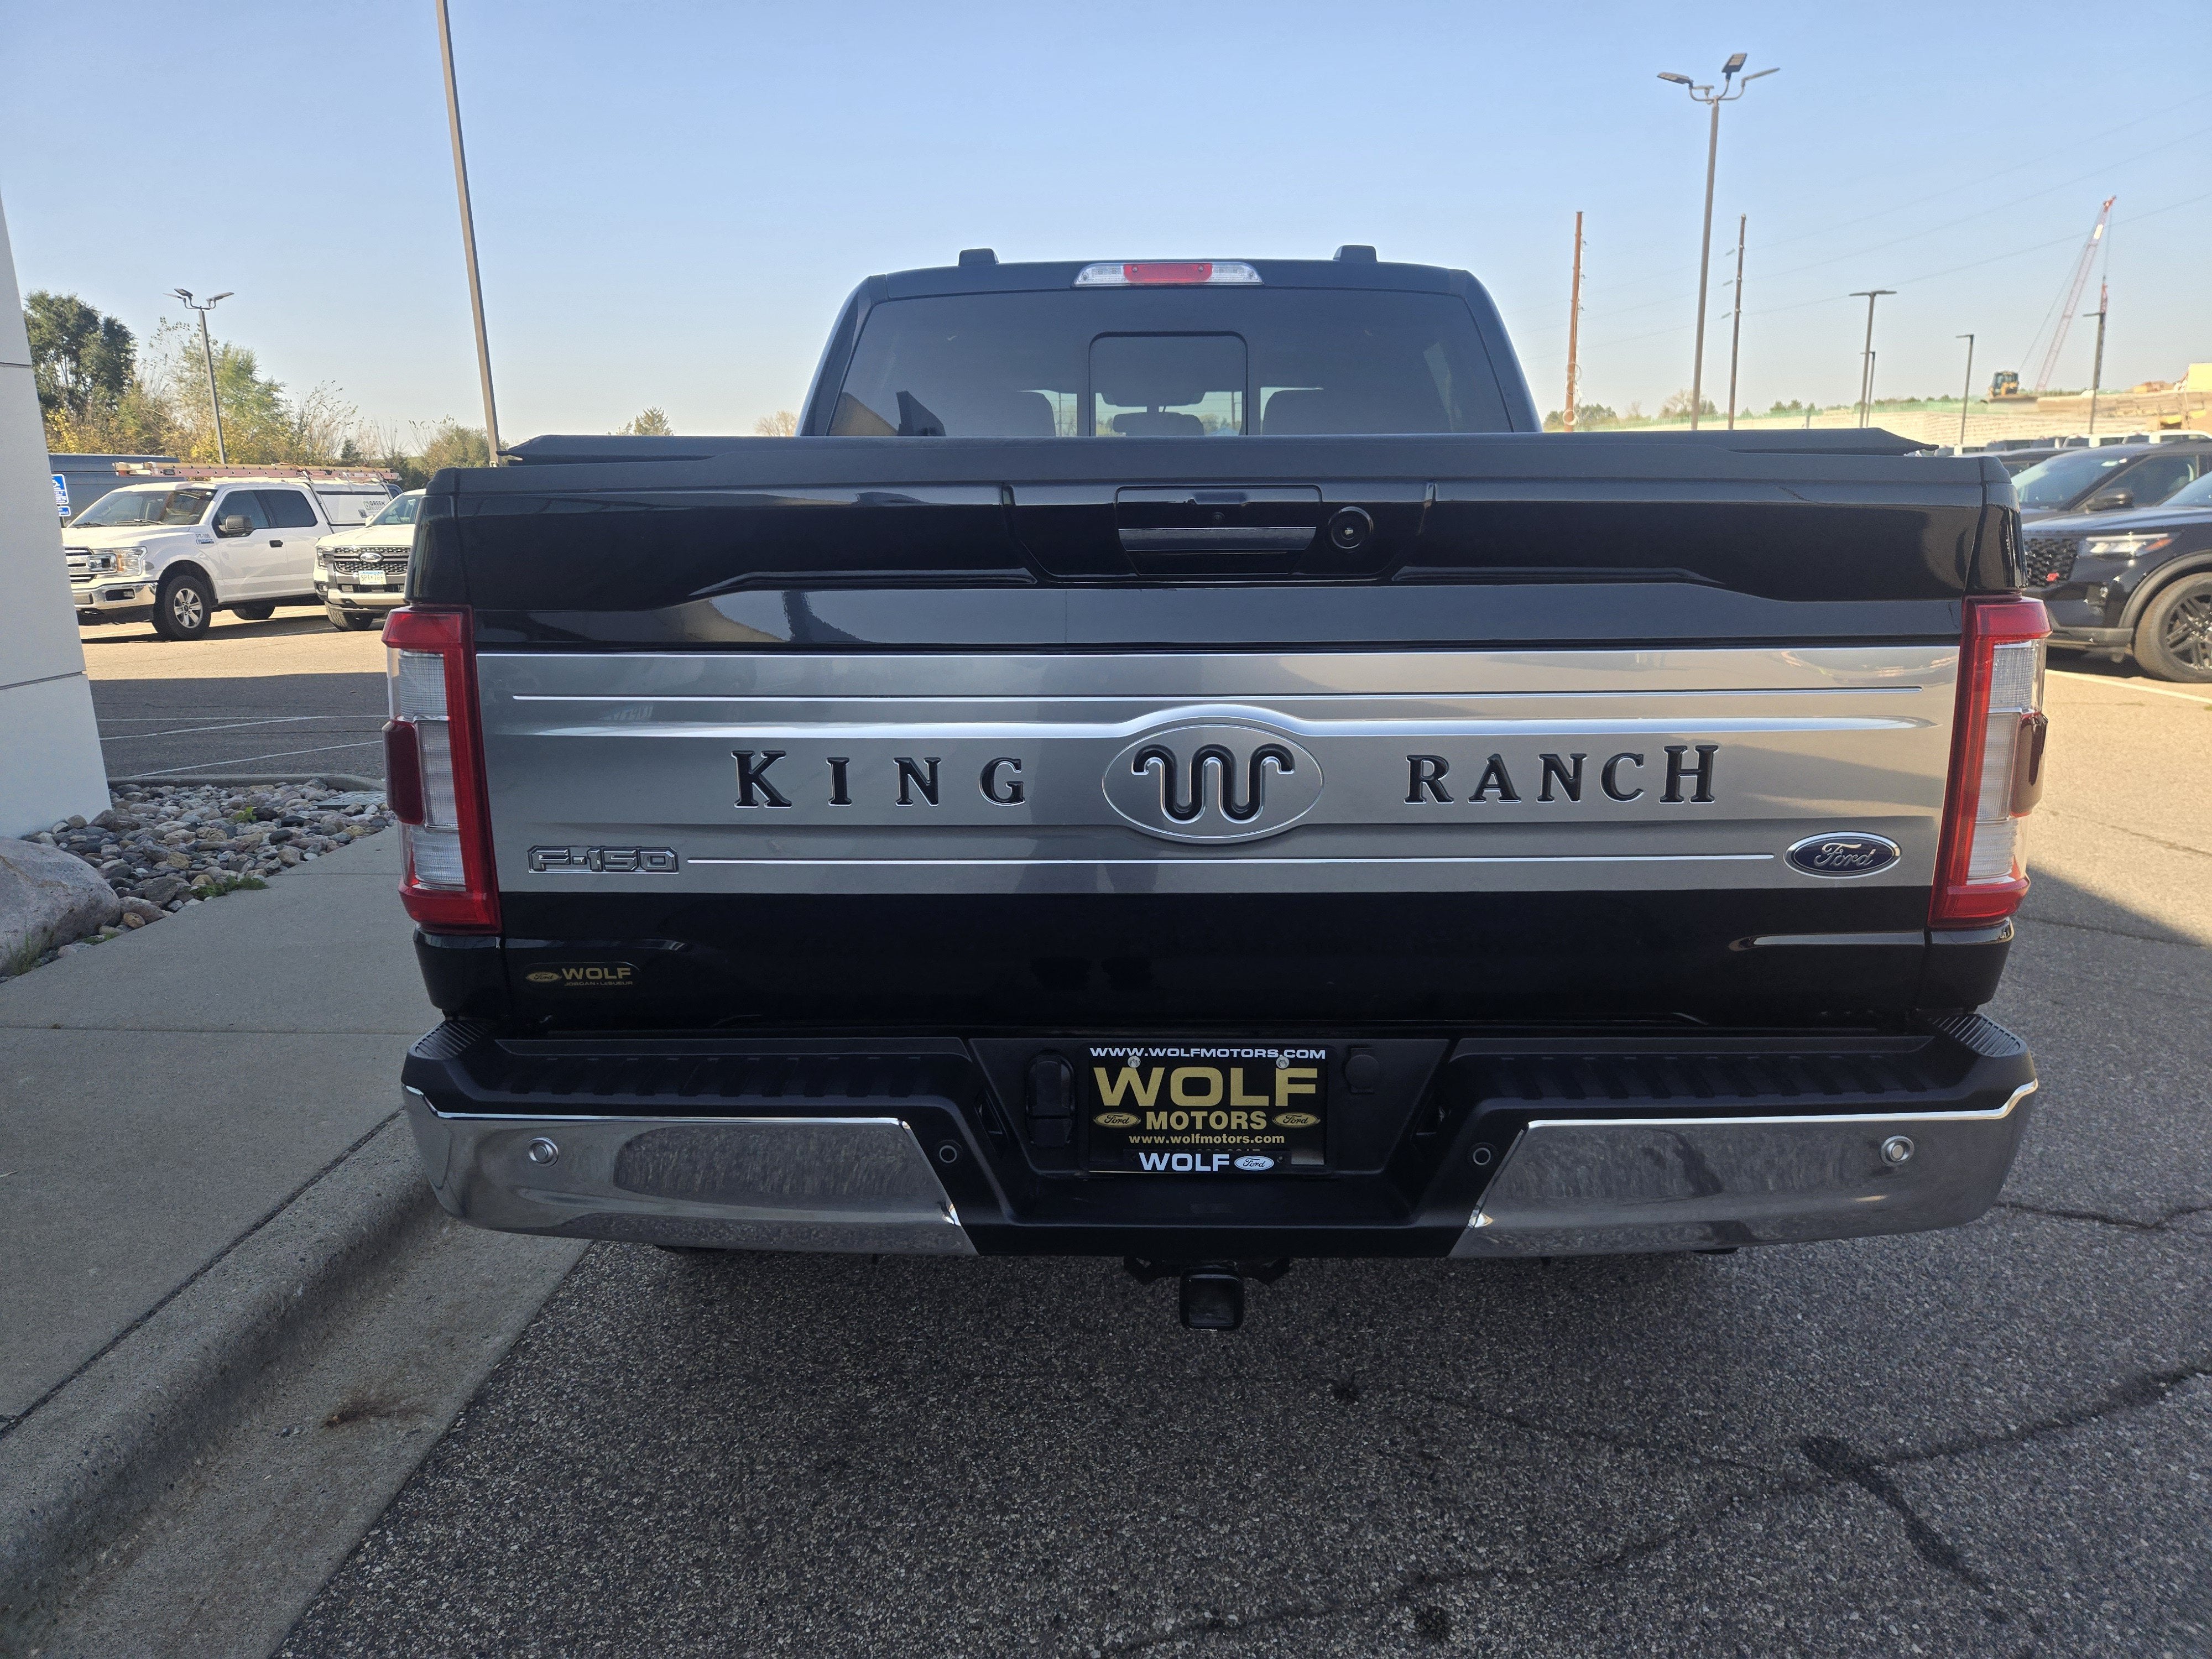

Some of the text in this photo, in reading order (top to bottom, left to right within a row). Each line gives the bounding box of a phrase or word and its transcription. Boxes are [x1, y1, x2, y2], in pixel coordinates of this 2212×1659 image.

[731, 745, 1719, 808] KING RANCH
[527, 845, 679, 874] F-150
[1814, 842, 1876, 867] Ford
[561, 967, 631, 980] WOLF
[1089, 1047, 1326, 1060] WWW.WOLFMOTORS.COM
[1093, 1067, 1318, 1107] WOLF
[1104, 1110, 1308, 1130] Ford MOTORS Ford
[1129, 1133, 1285, 1144] www.wolfmotors.com
[1138, 1152, 1266, 1172] WOLF Ford
